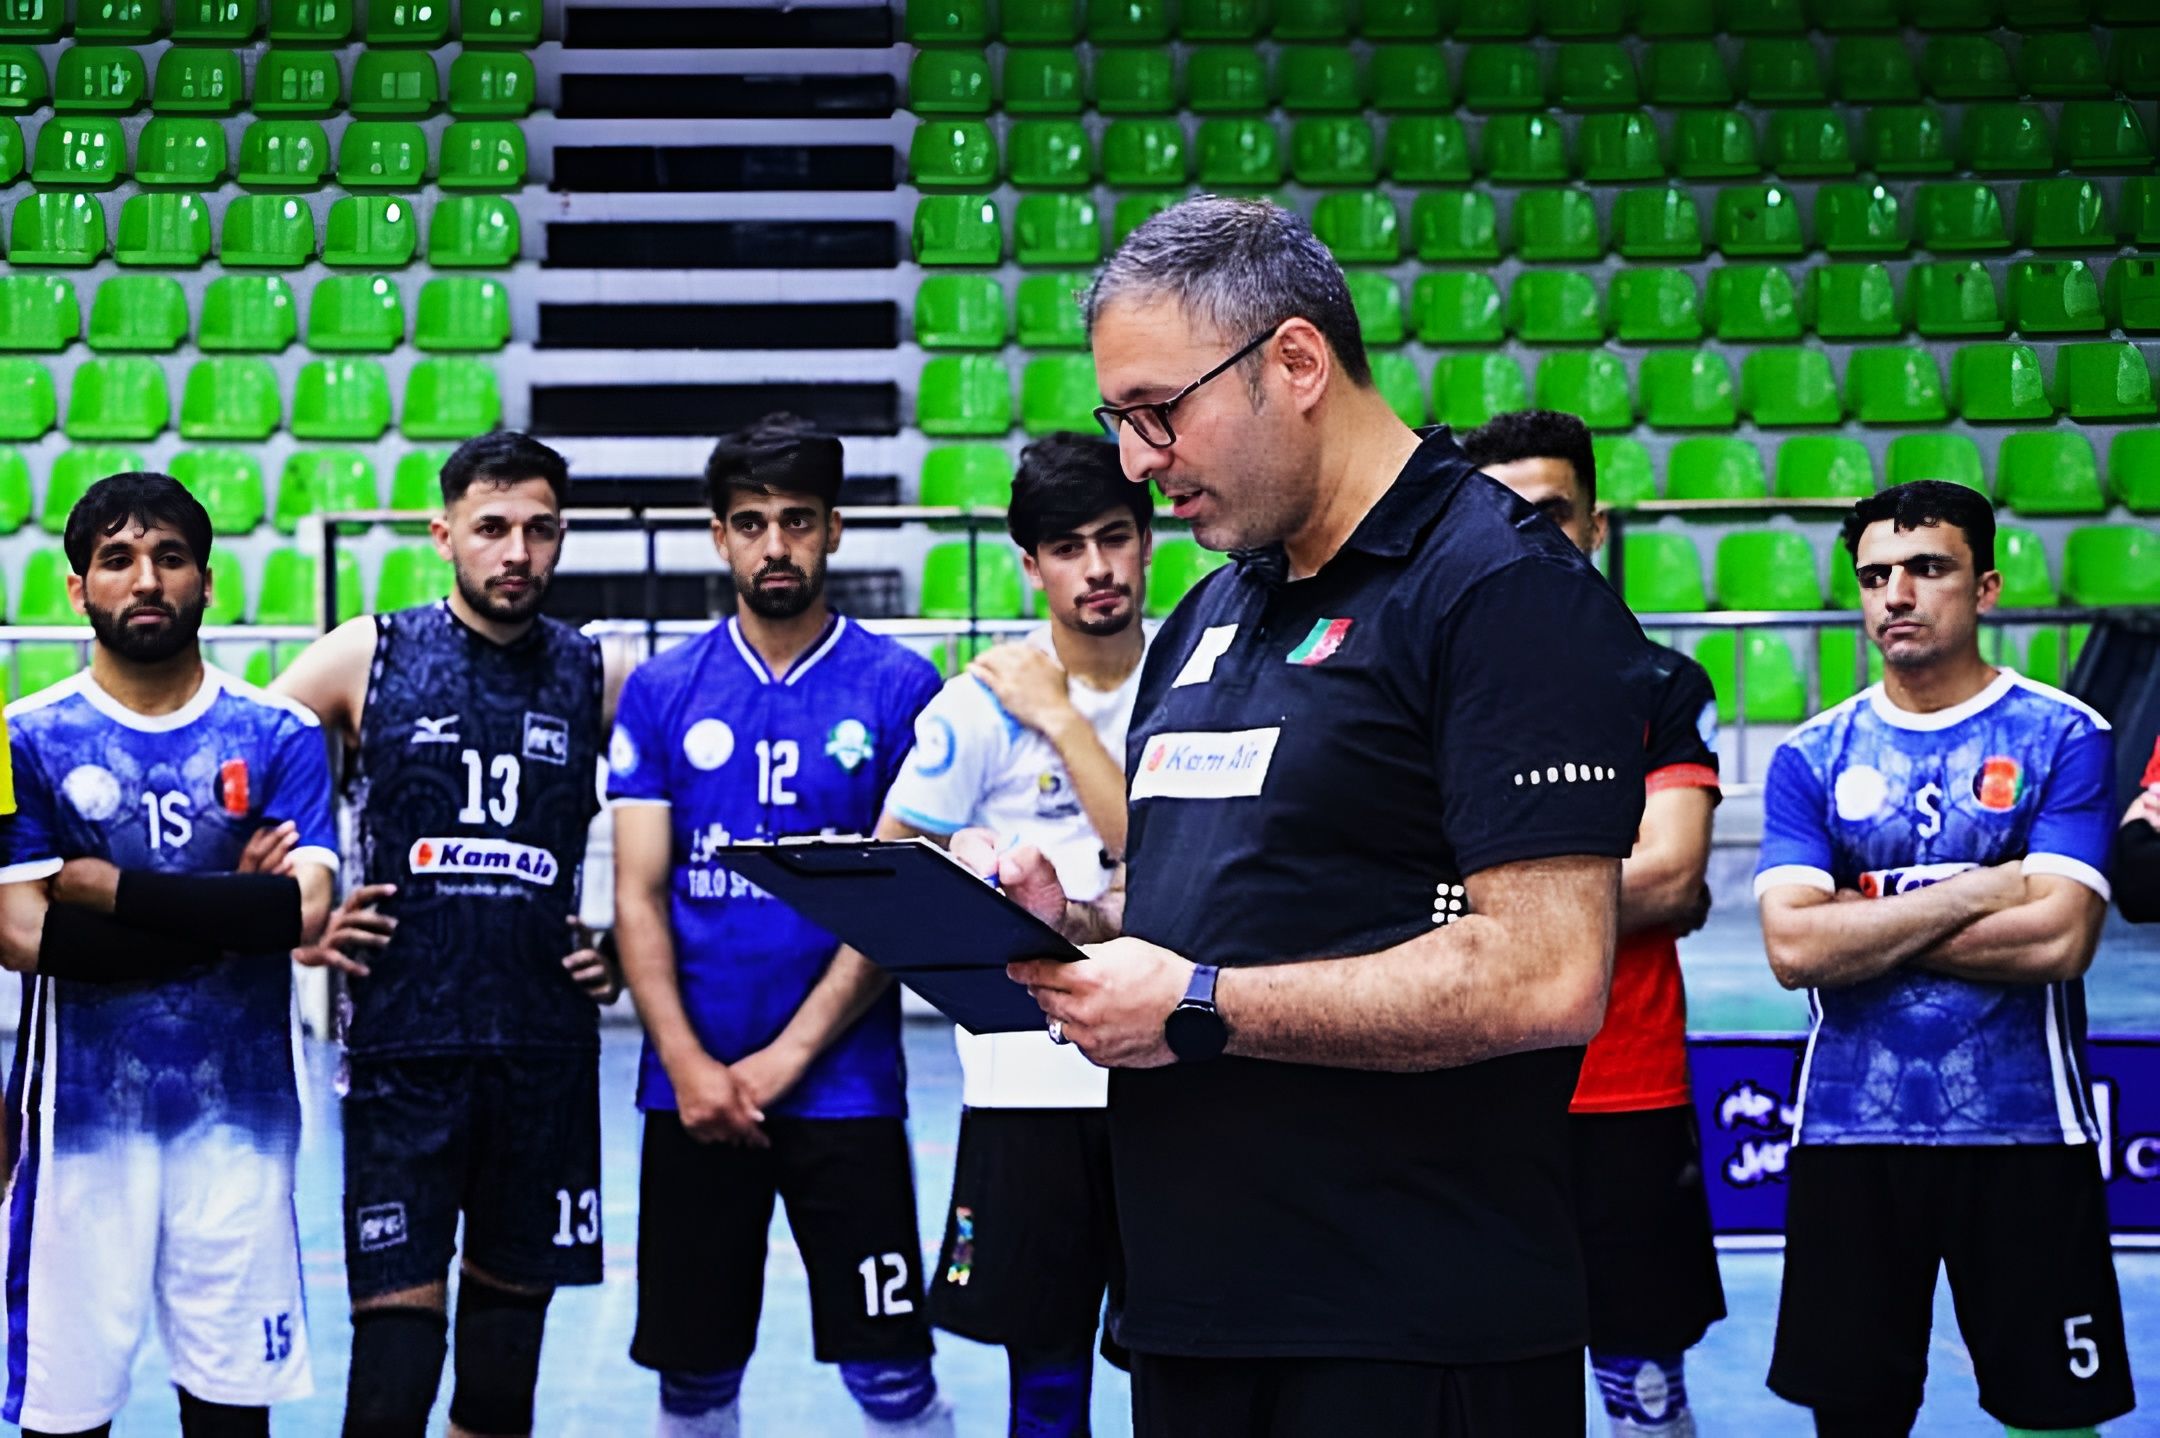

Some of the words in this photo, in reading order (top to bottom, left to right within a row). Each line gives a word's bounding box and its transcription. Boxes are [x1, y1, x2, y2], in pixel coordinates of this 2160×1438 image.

[754, 739, 800, 806] 12
[1166, 745, 1225, 771] Kam
[1228, 742, 1259, 769] Air
[458, 749, 521, 827] 13
[439, 844, 511, 868] Kam
[516, 852, 552, 878] Air
[552, 1188, 599, 1246] 13
[858, 1252, 914, 1317] 12
[263, 1312, 292, 1362] 15
[2063, 1313, 2100, 1379] 5
